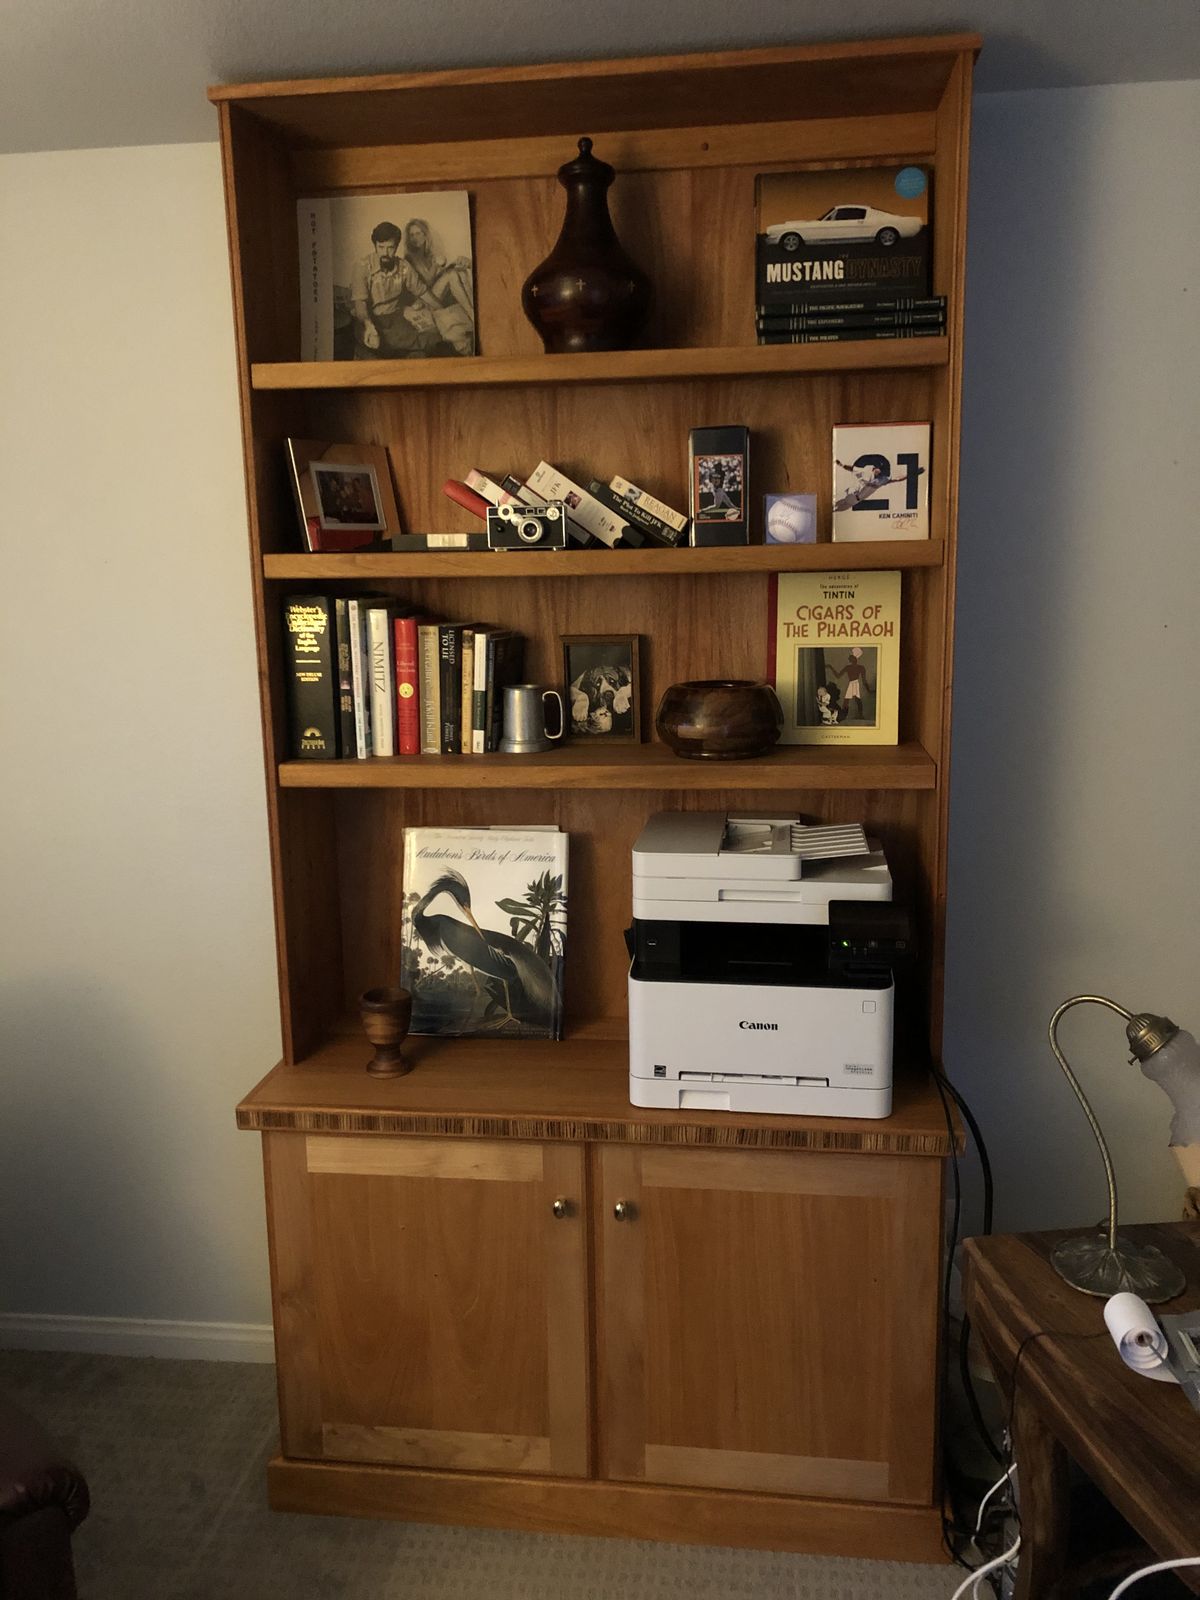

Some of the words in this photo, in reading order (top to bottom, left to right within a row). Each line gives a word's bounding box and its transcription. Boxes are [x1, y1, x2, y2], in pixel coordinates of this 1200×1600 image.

[766, 260, 845, 283] MUSTANG
[848, 256, 922, 280] DYNASTY
[852, 453, 919, 511] 21
[612, 494, 623, 503] The
[622, 500, 634, 510] Plot
[634, 507, 641, 515] To
[641, 512, 652, 521] Kill
[650, 519, 662, 529] JFK
[823, 591, 855, 599] TINTIN
[796, 604, 855, 621] CIGARS
[862, 605, 882, 620] OF
[783, 622, 809, 638] THE
[817, 620, 894, 638] PHARAOH
[441, 633, 449, 646] TO
[448, 630, 456, 664] LICENSED
[441, 646, 449, 660] LIE
[373, 641, 386, 693] NIMITZ
[416, 847, 463, 861] Audubon's
[468, 848, 496, 861] Birds
[497, 850, 512, 865] of
[511, 849, 557, 864] America
[739, 1020, 778, 1031] Canon
